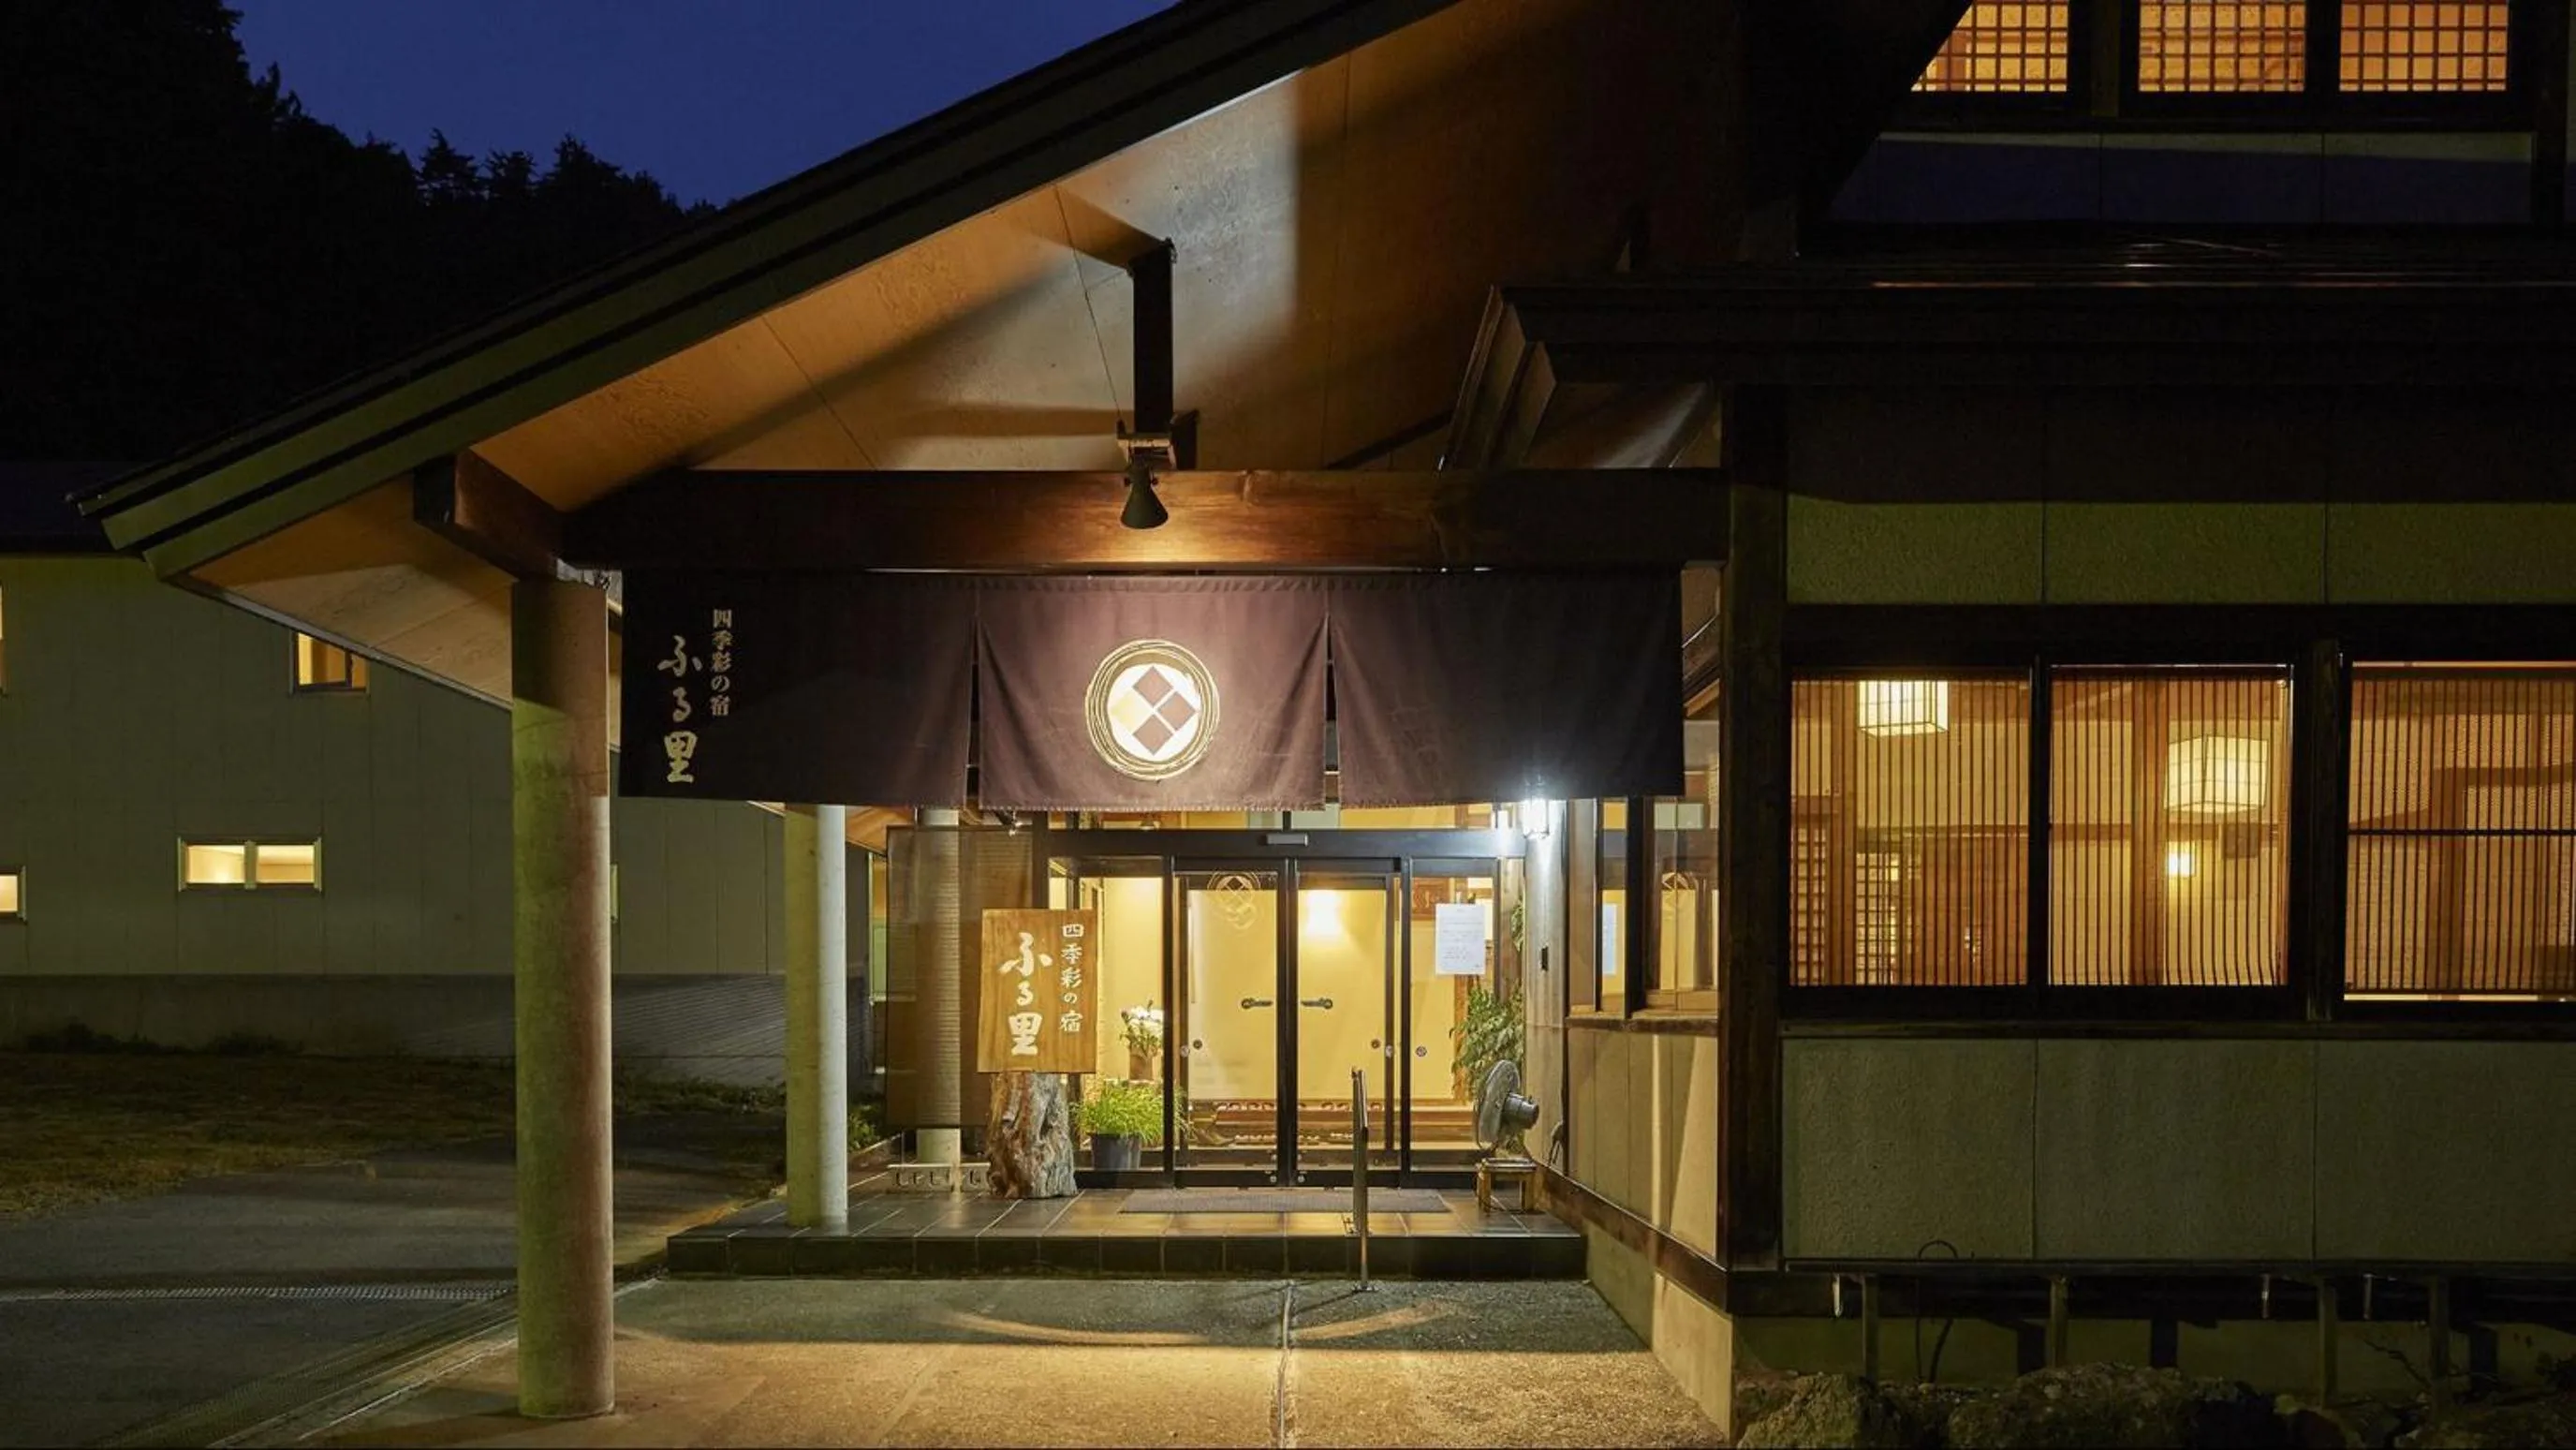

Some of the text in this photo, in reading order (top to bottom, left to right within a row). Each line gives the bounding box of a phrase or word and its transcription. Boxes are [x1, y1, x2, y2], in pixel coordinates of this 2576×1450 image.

[657, 635, 701, 783] ふる里
[710, 609, 733, 717] 四季彩の宿
[998, 932, 1052, 1056] ふる里
[1060, 924, 1084, 1031] 四季彩の宿
